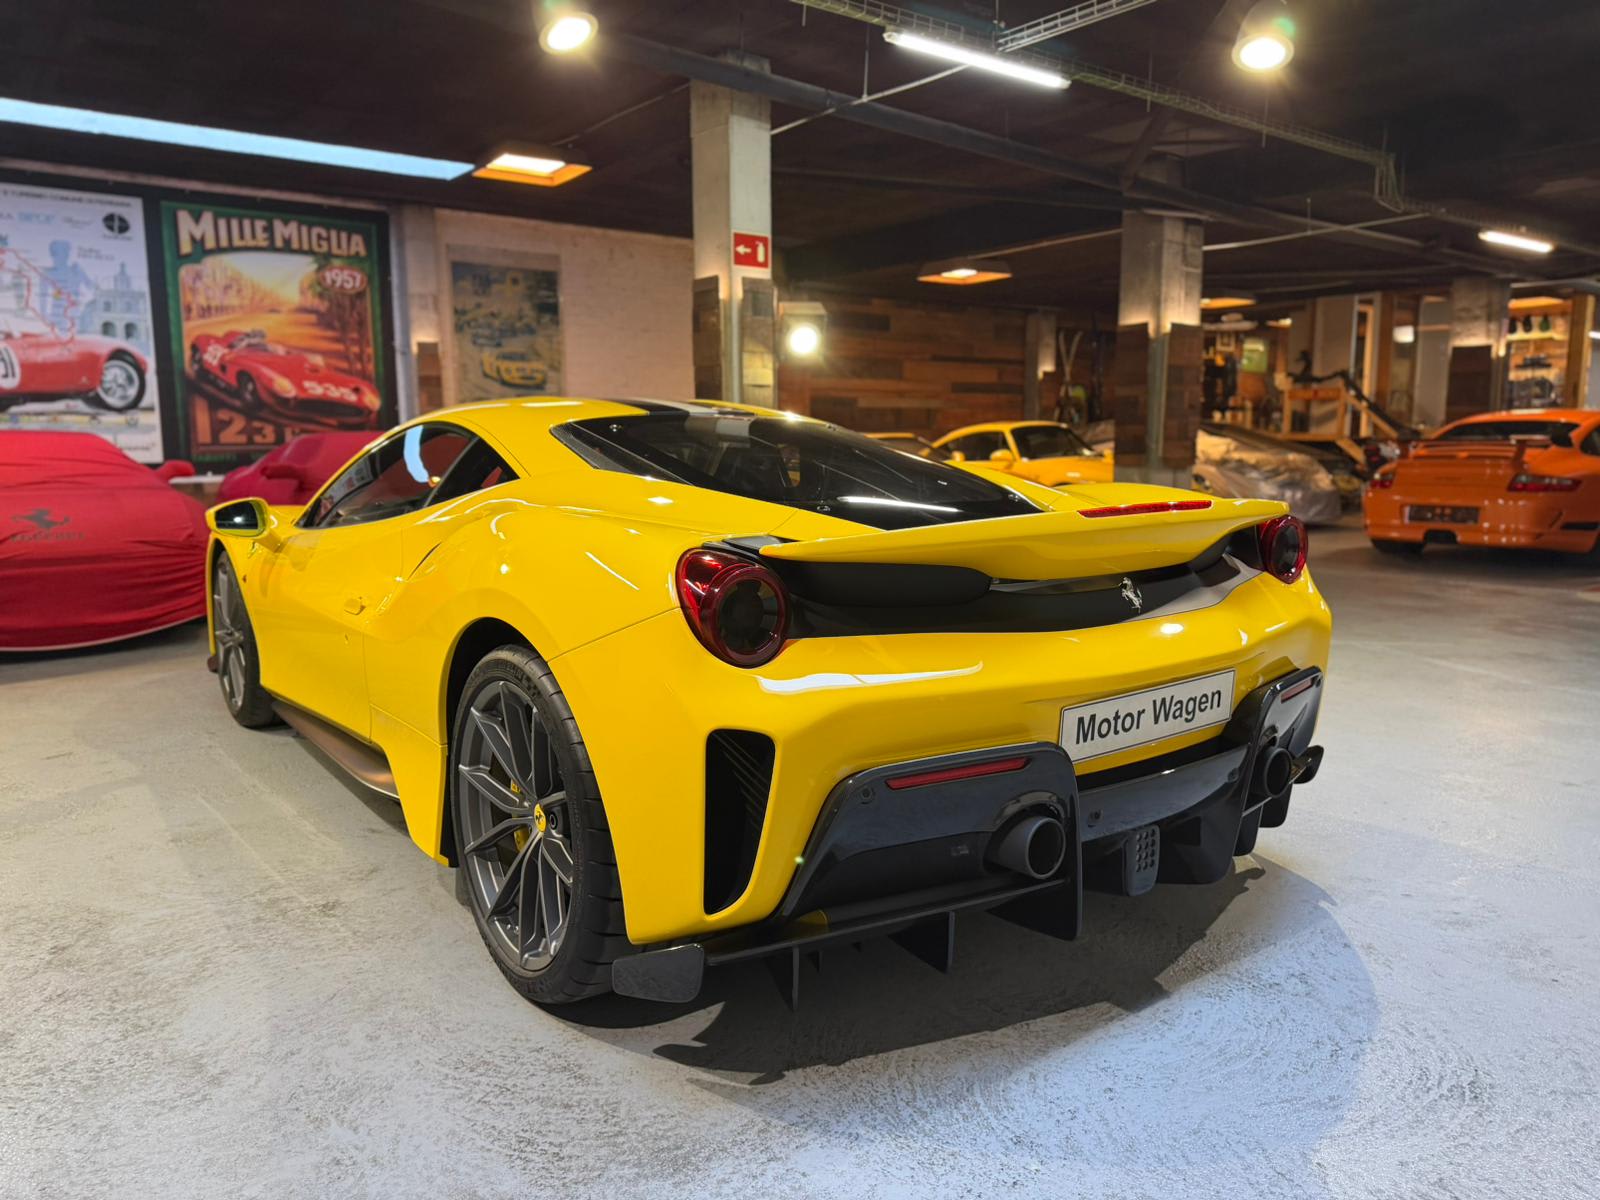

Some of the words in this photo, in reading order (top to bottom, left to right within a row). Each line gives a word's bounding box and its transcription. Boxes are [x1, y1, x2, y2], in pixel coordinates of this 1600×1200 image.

[176, 209, 270, 257] MILLE
[273, 218, 368, 257] MIGLIA
[324, 268, 361, 289] 1957
[1075, 708, 1146, 745] Motor
[1152, 689, 1222, 725] Wagen
